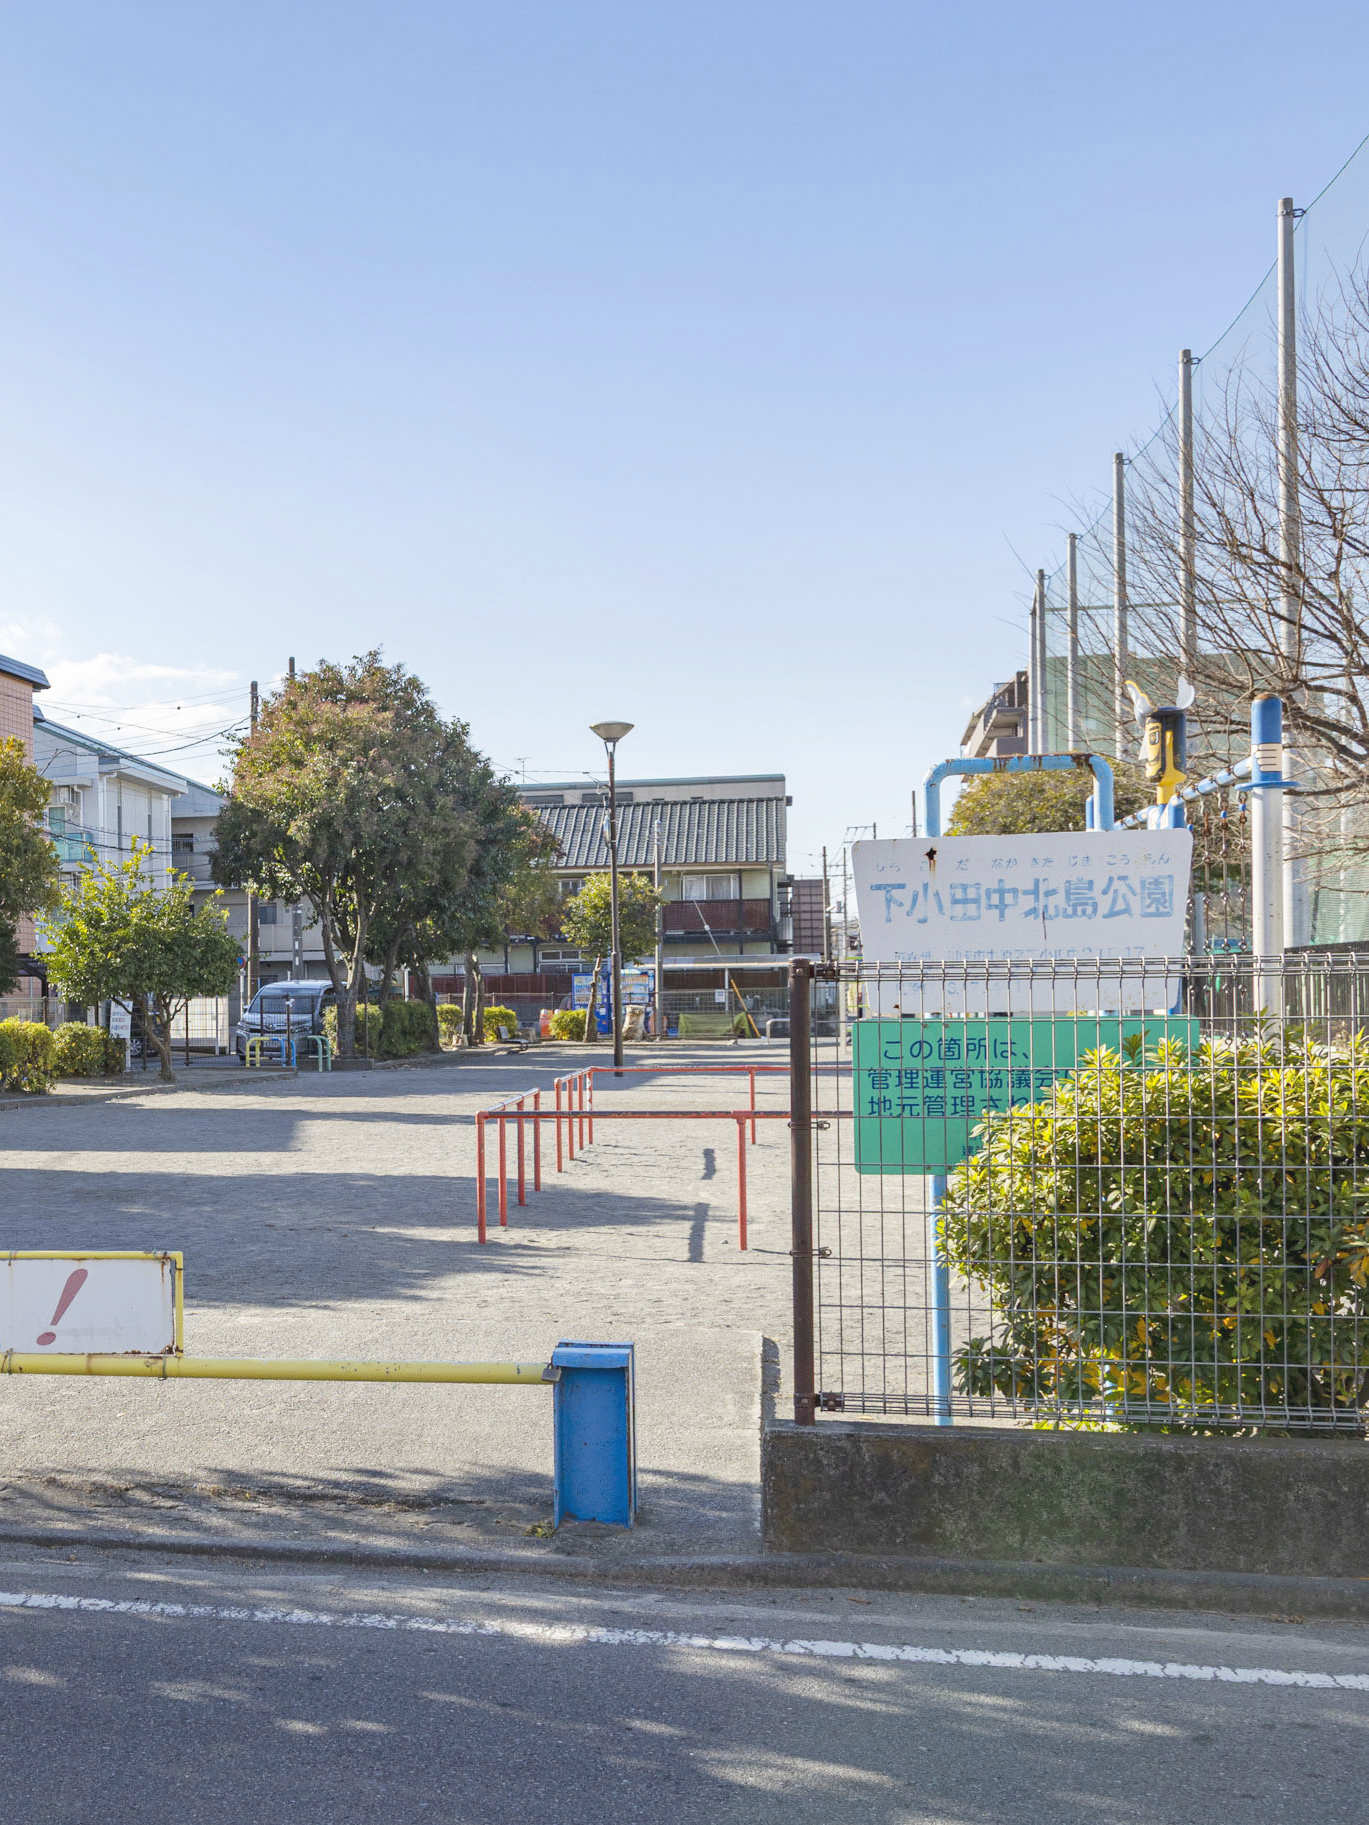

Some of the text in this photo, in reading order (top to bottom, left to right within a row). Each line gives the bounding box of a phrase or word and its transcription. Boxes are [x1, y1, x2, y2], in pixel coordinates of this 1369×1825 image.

[956, 858, 971, 871] だ
[992, 857, 1019, 870] なか
[1106, 854, 1131, 866] こう
[869, 873, 1175, 924] 下小田中北島公園
[884, 1036, 1031, 1061] この箇所は、
[867, 1095, 1052, 1118] 地元管理さ
